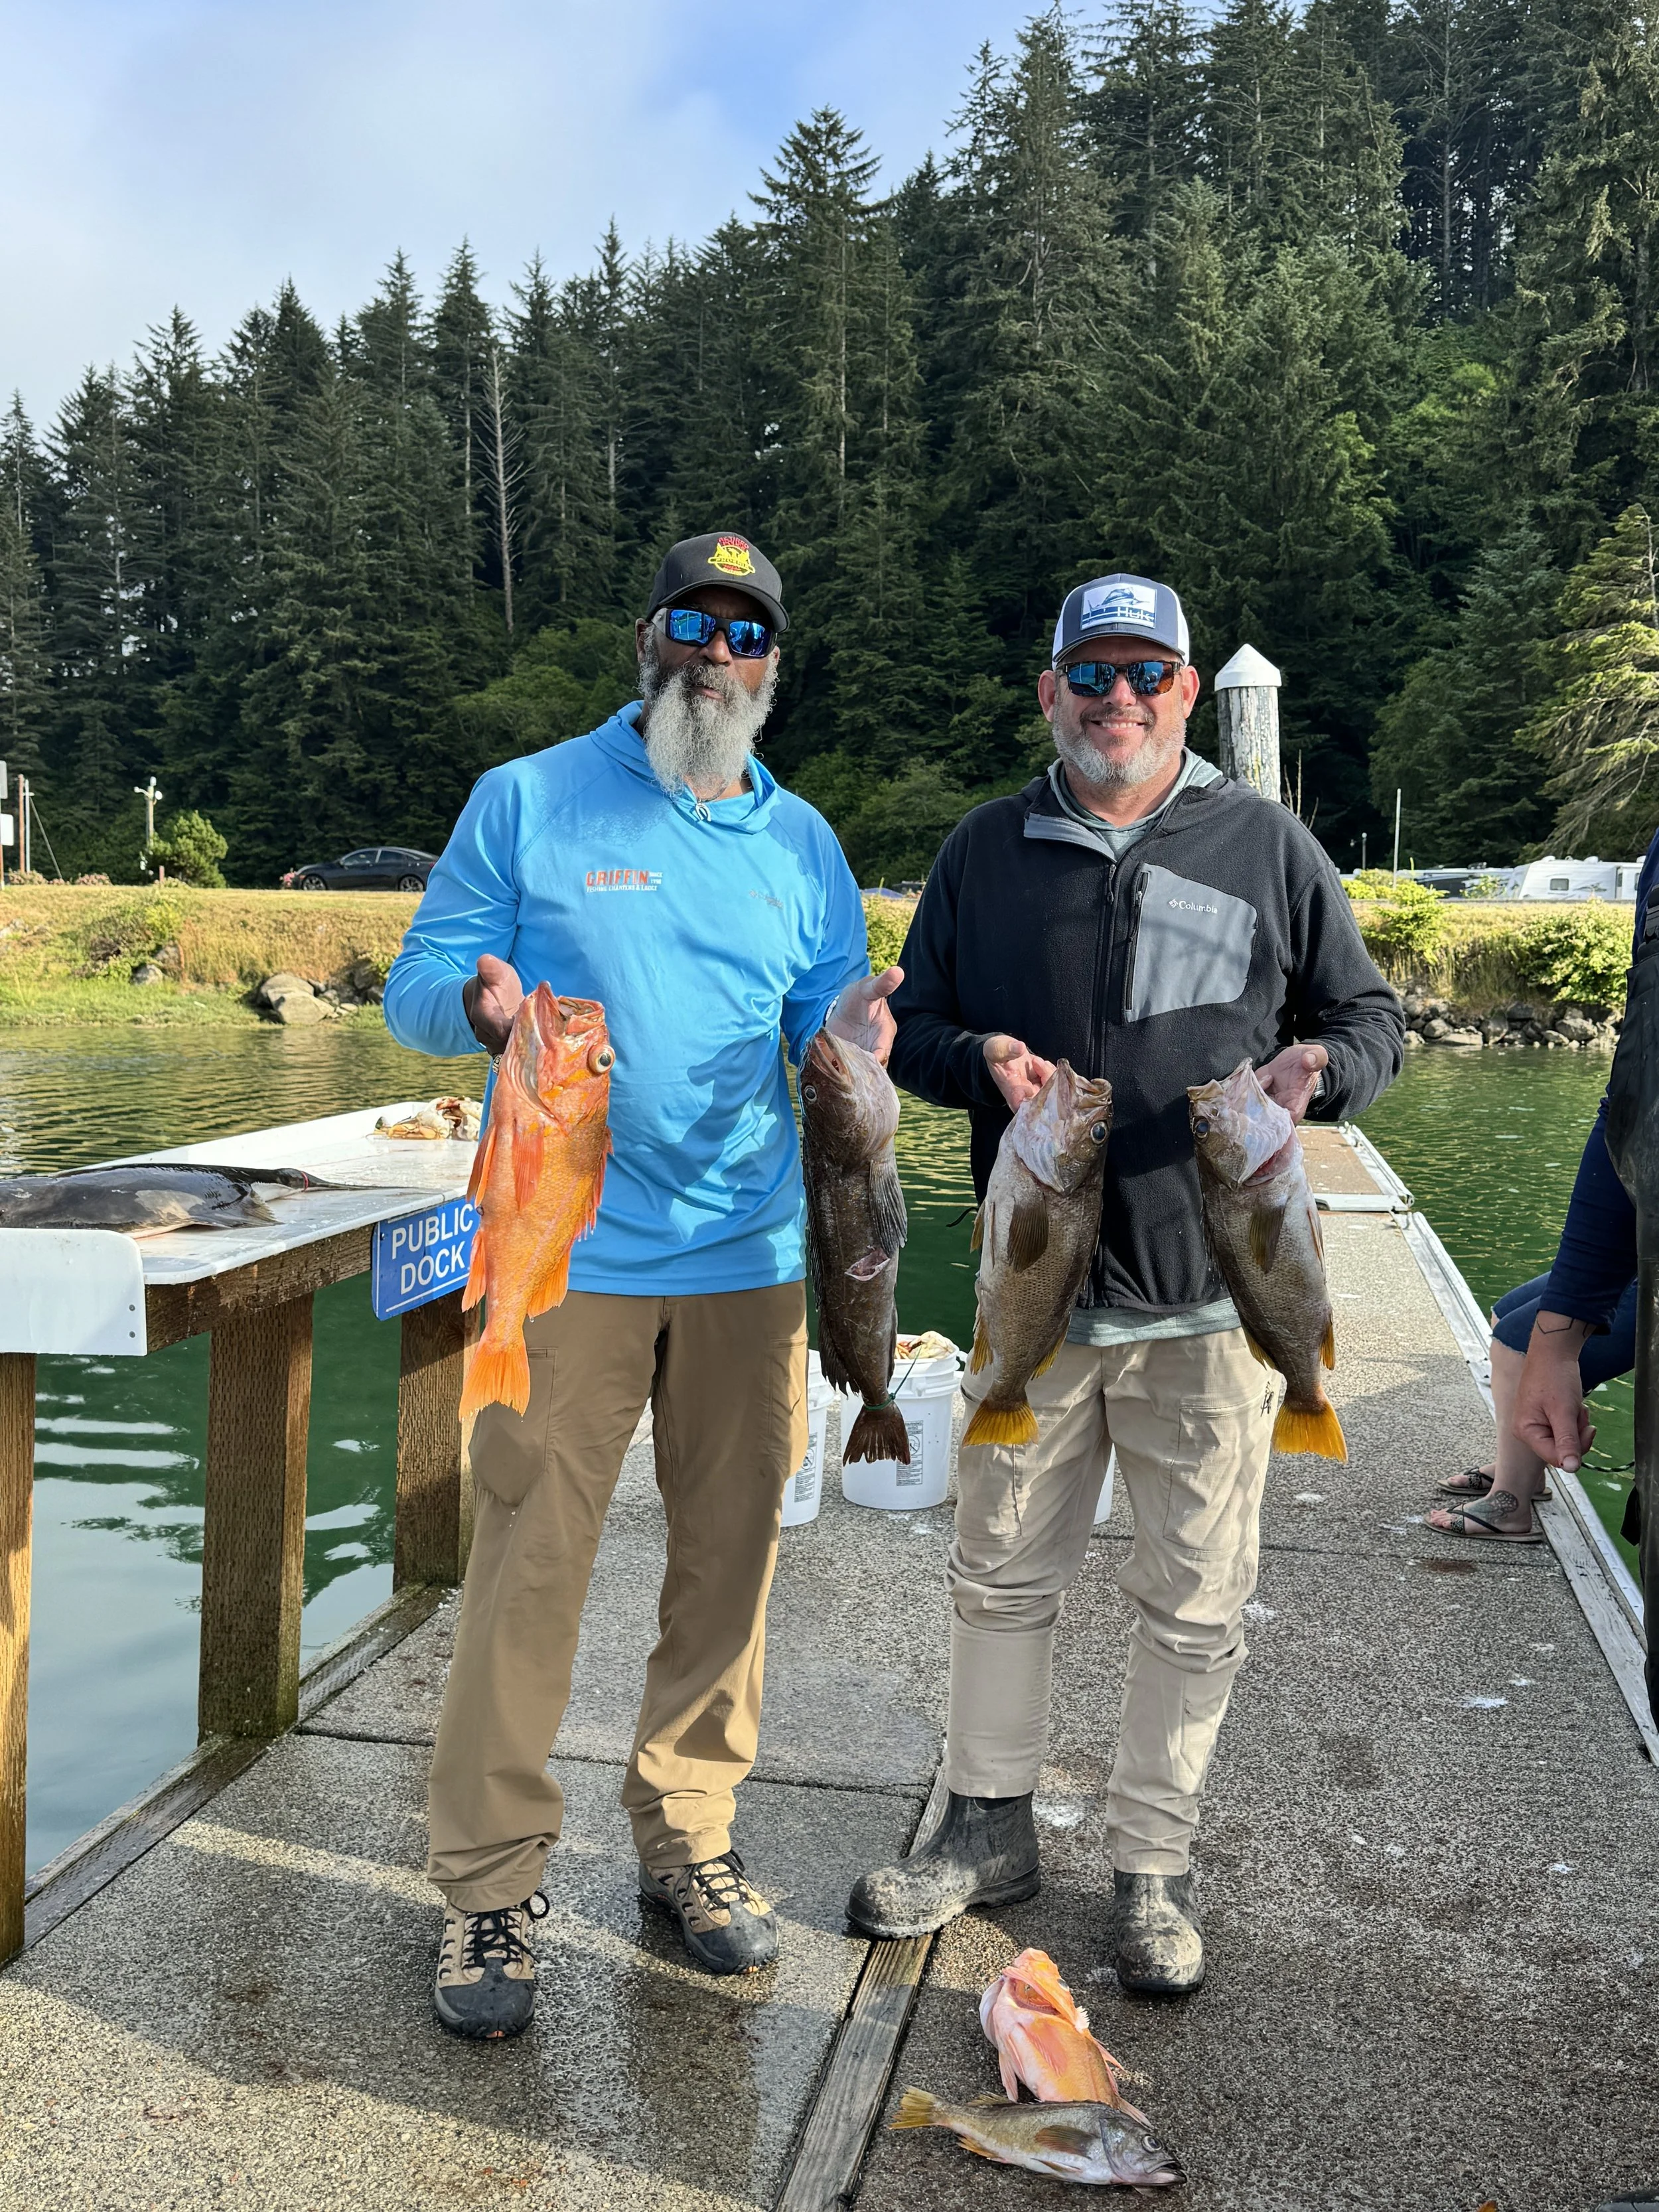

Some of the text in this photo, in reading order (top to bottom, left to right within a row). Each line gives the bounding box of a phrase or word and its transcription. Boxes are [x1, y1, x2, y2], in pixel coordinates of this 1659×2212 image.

[586, 869, 649, 887] GRIFFIN
[1179, 901, 1218, 914] Columbia
[392, 1203, 473, 1260] PUBLIC
[401, 1241, 465, 1294] DOCK
